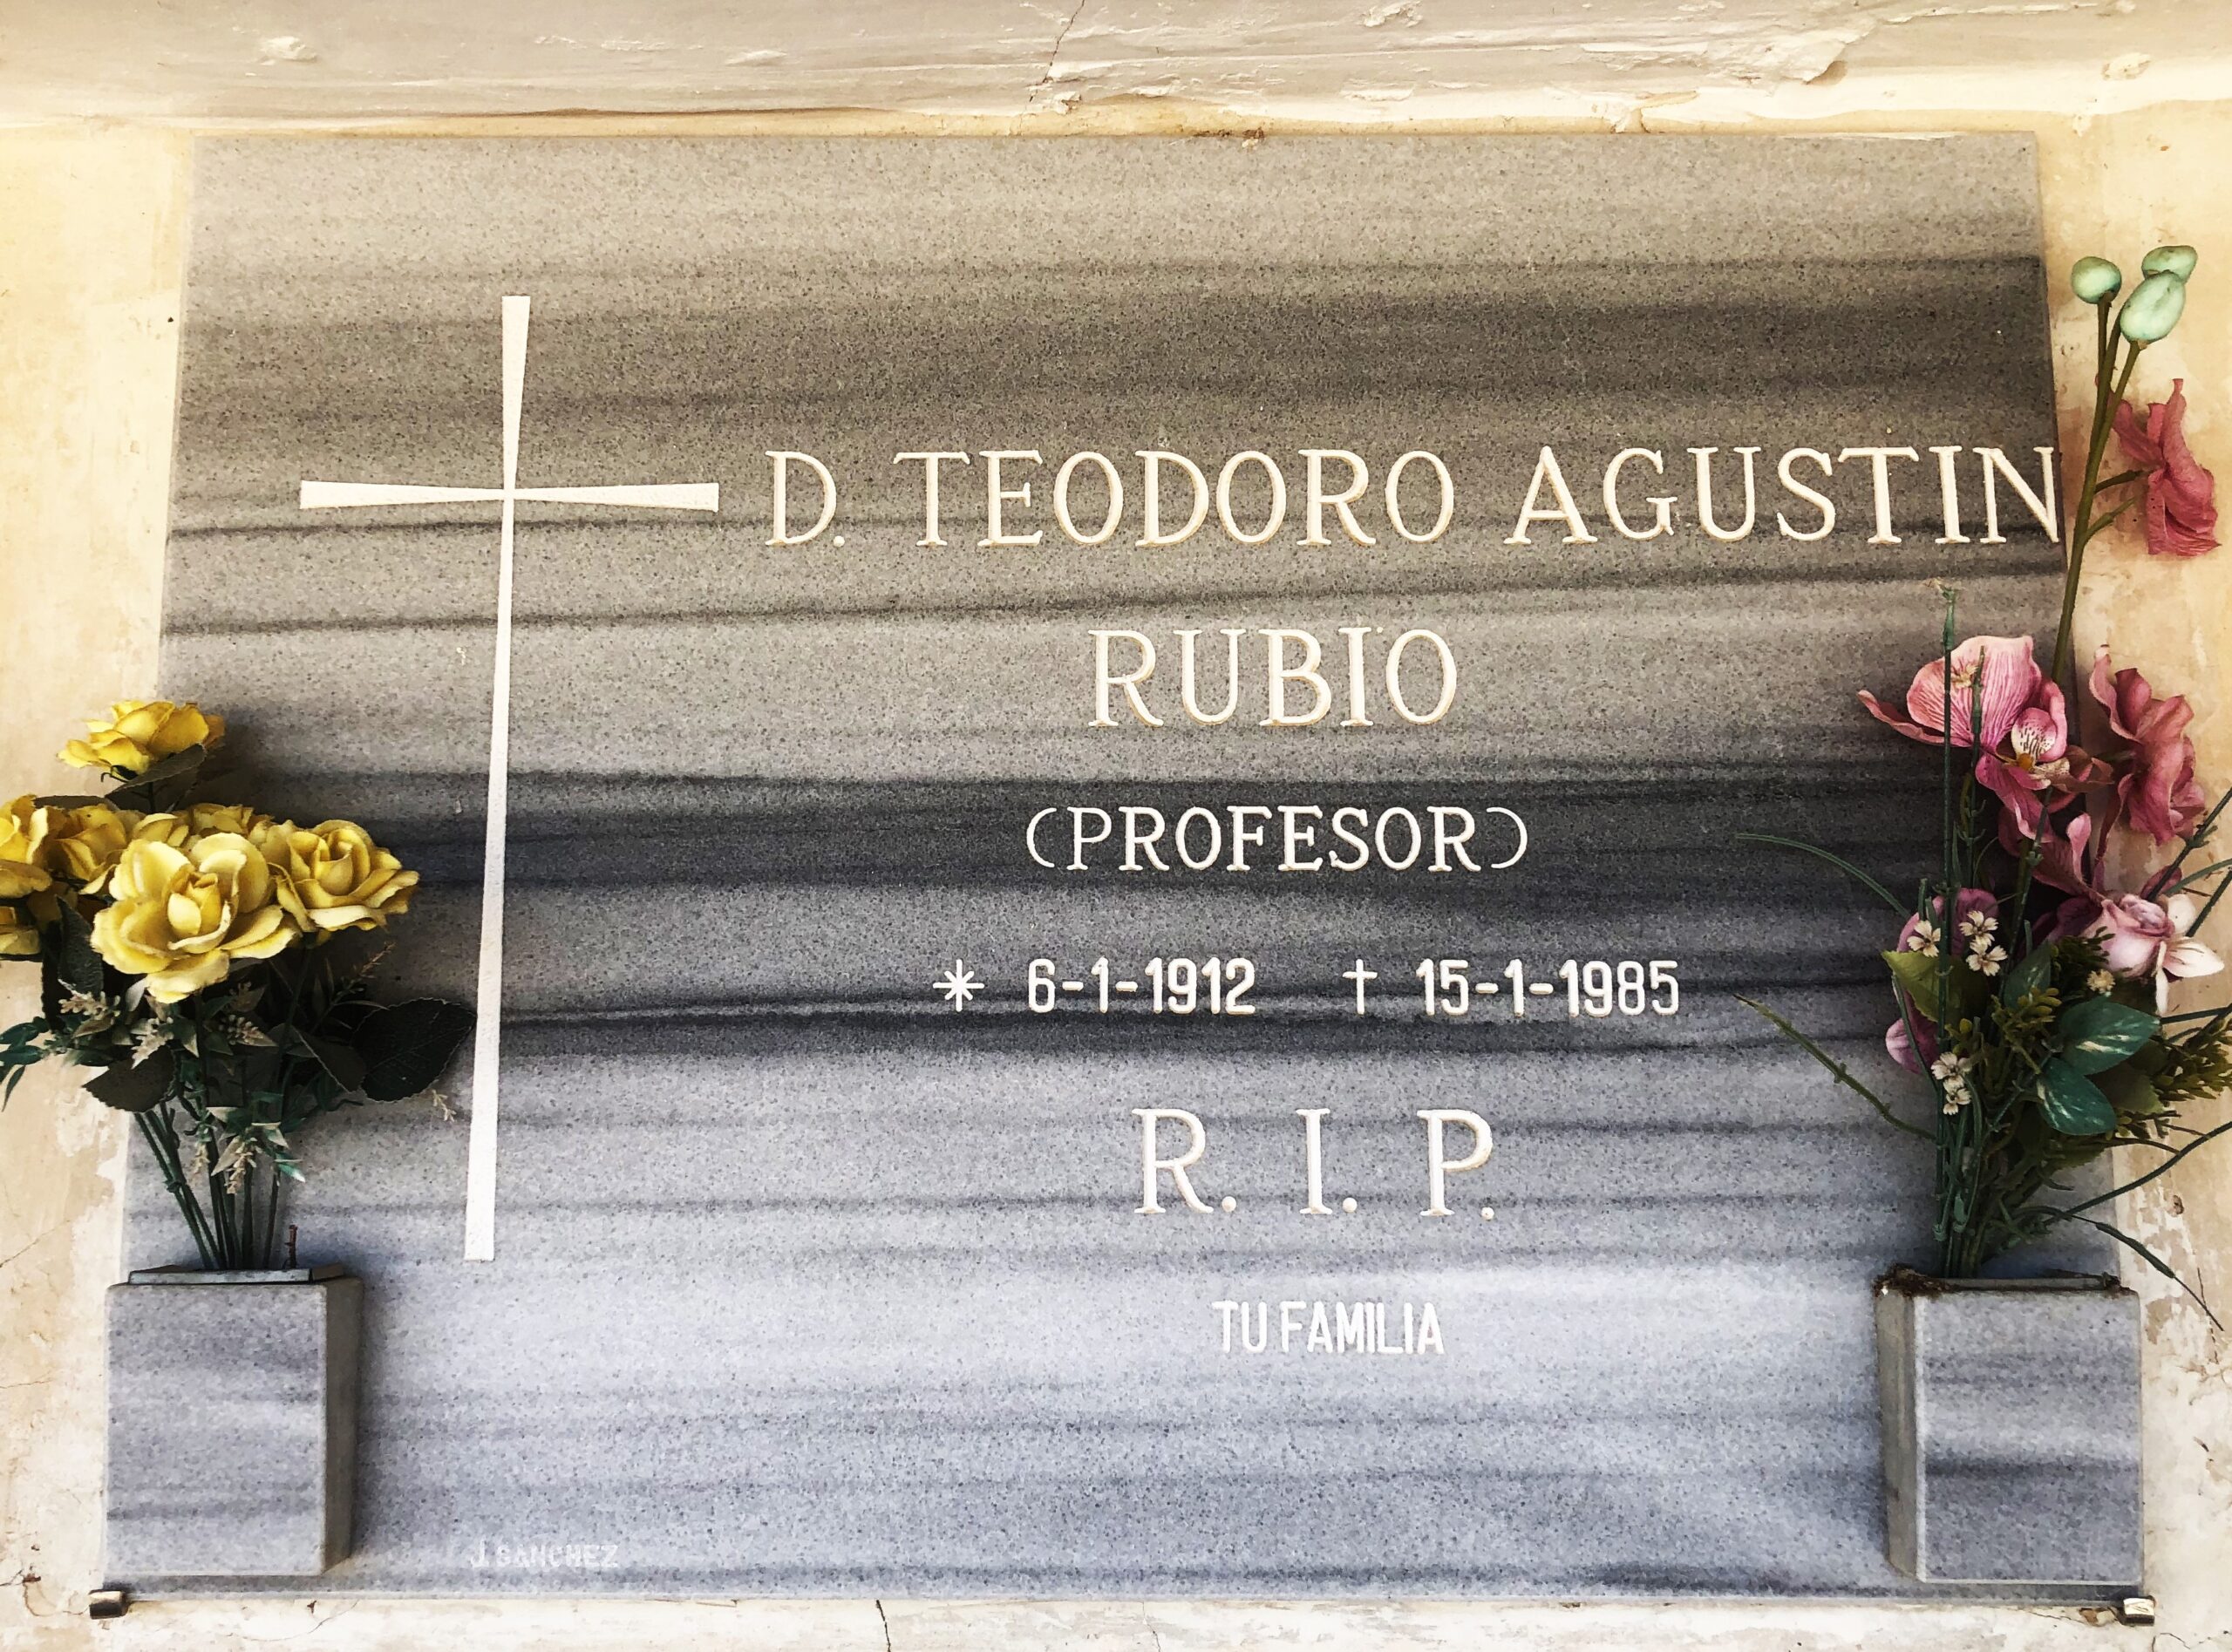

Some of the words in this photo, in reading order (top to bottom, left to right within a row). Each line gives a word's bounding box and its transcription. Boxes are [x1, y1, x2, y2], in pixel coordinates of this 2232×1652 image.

[764, 450, 845, 547] D.
[893, 450, 1453, 546] TEODORO
[1503, 445, 2059, 545] AGUSTIN
[1089, 627, 1457, 727] RUBIO
[1026, 806, 1528, 872] (PROFESOR)
[1027, 957, 1256, 1015] 6-1-1912
[1416, 957, 1680, 1017] 15-1-1985
[1132, 1108, 1236, 1214] R.
[1296, 1108, 1358, 1214] I.
[1417, 1109, 1494, 1220] P.
[1212, 1300, 1267, 1353] TU
[1279, 1300, 1445, 1355] FAMILIA
